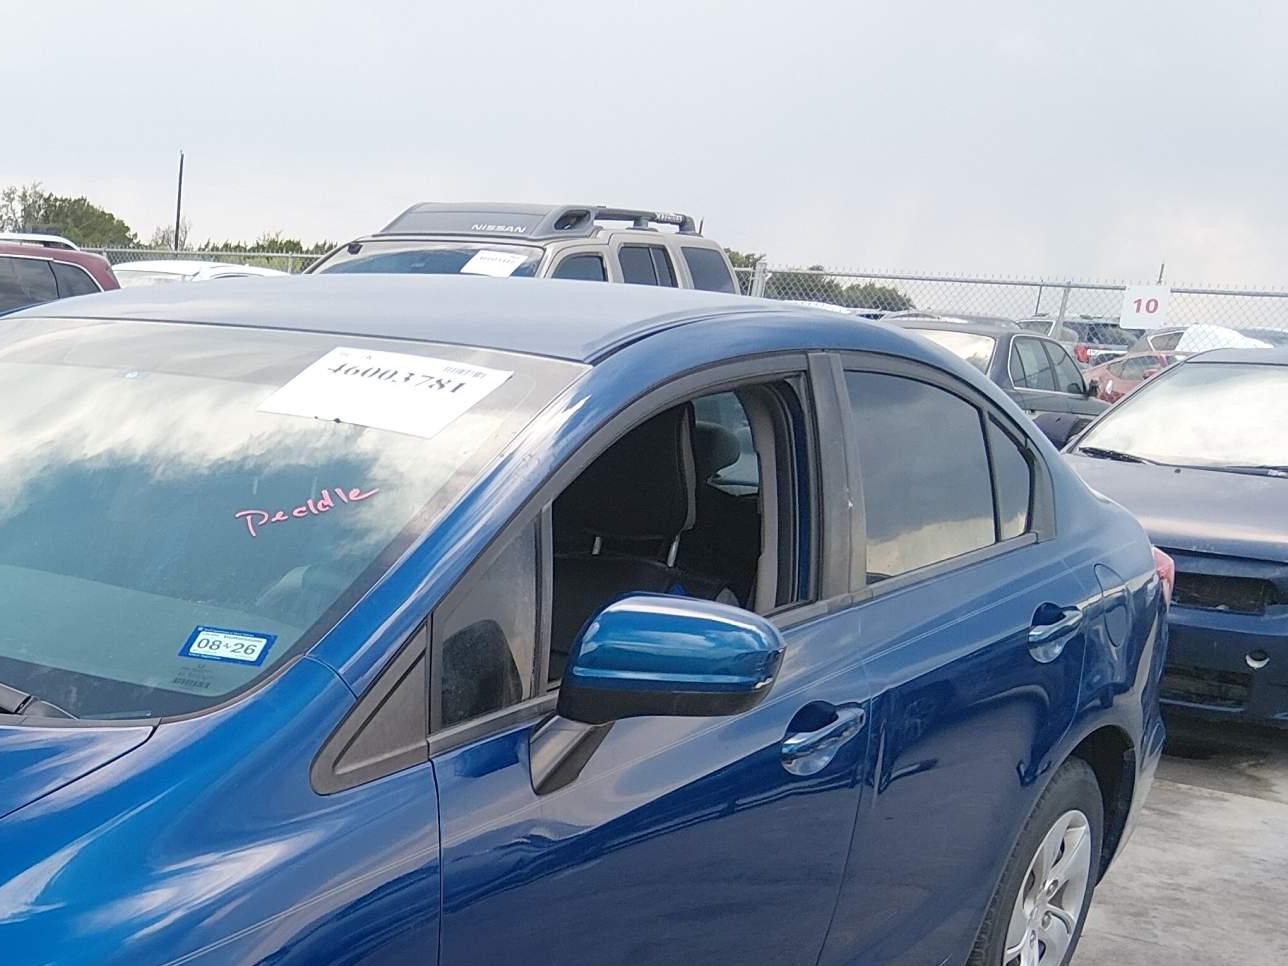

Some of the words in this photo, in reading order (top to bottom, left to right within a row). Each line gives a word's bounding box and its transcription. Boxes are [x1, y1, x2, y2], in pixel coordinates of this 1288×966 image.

[471, 223, 527, 233] NISSAN
[1133, 298, 1159, 314] 10
[327, 363, 465, 393] 46003781
